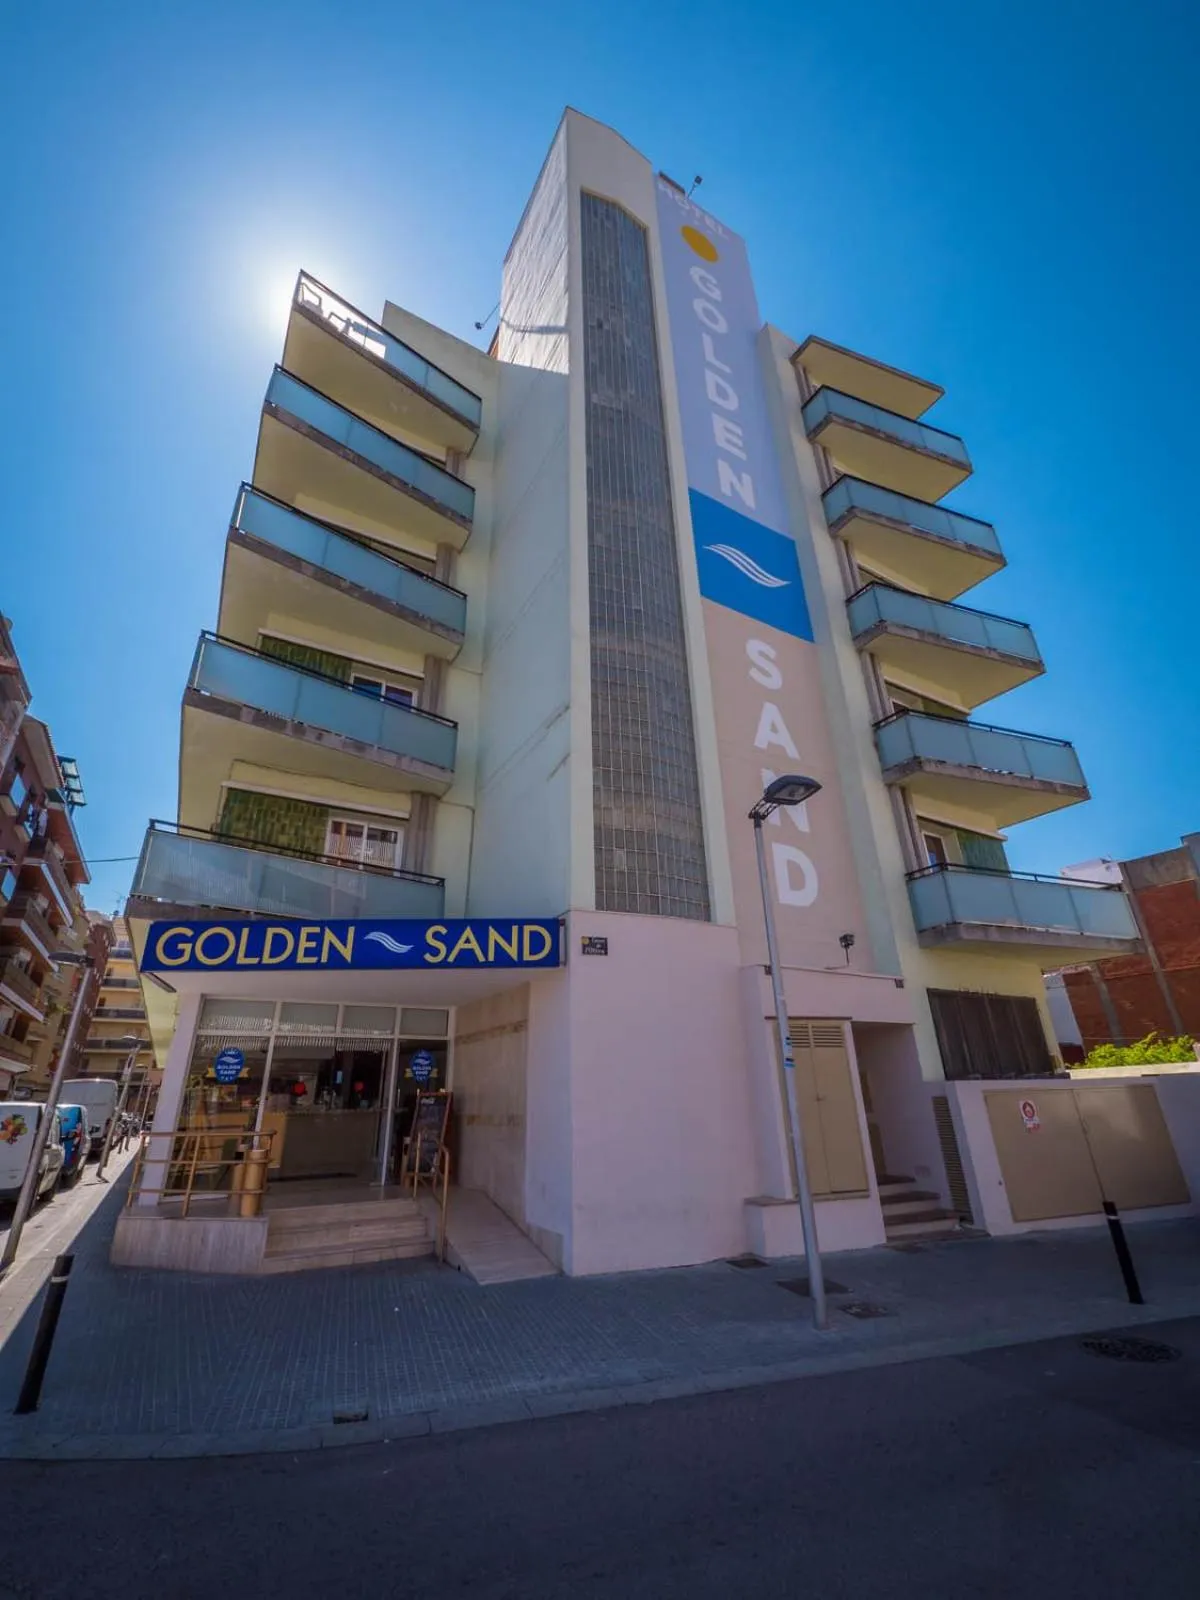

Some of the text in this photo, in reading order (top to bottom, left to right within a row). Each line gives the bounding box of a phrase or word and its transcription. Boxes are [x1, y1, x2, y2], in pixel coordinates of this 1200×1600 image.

[690, 266, 755, 509] GOLDEN
[155, 924, 552, 966] GOLDEN SAND
